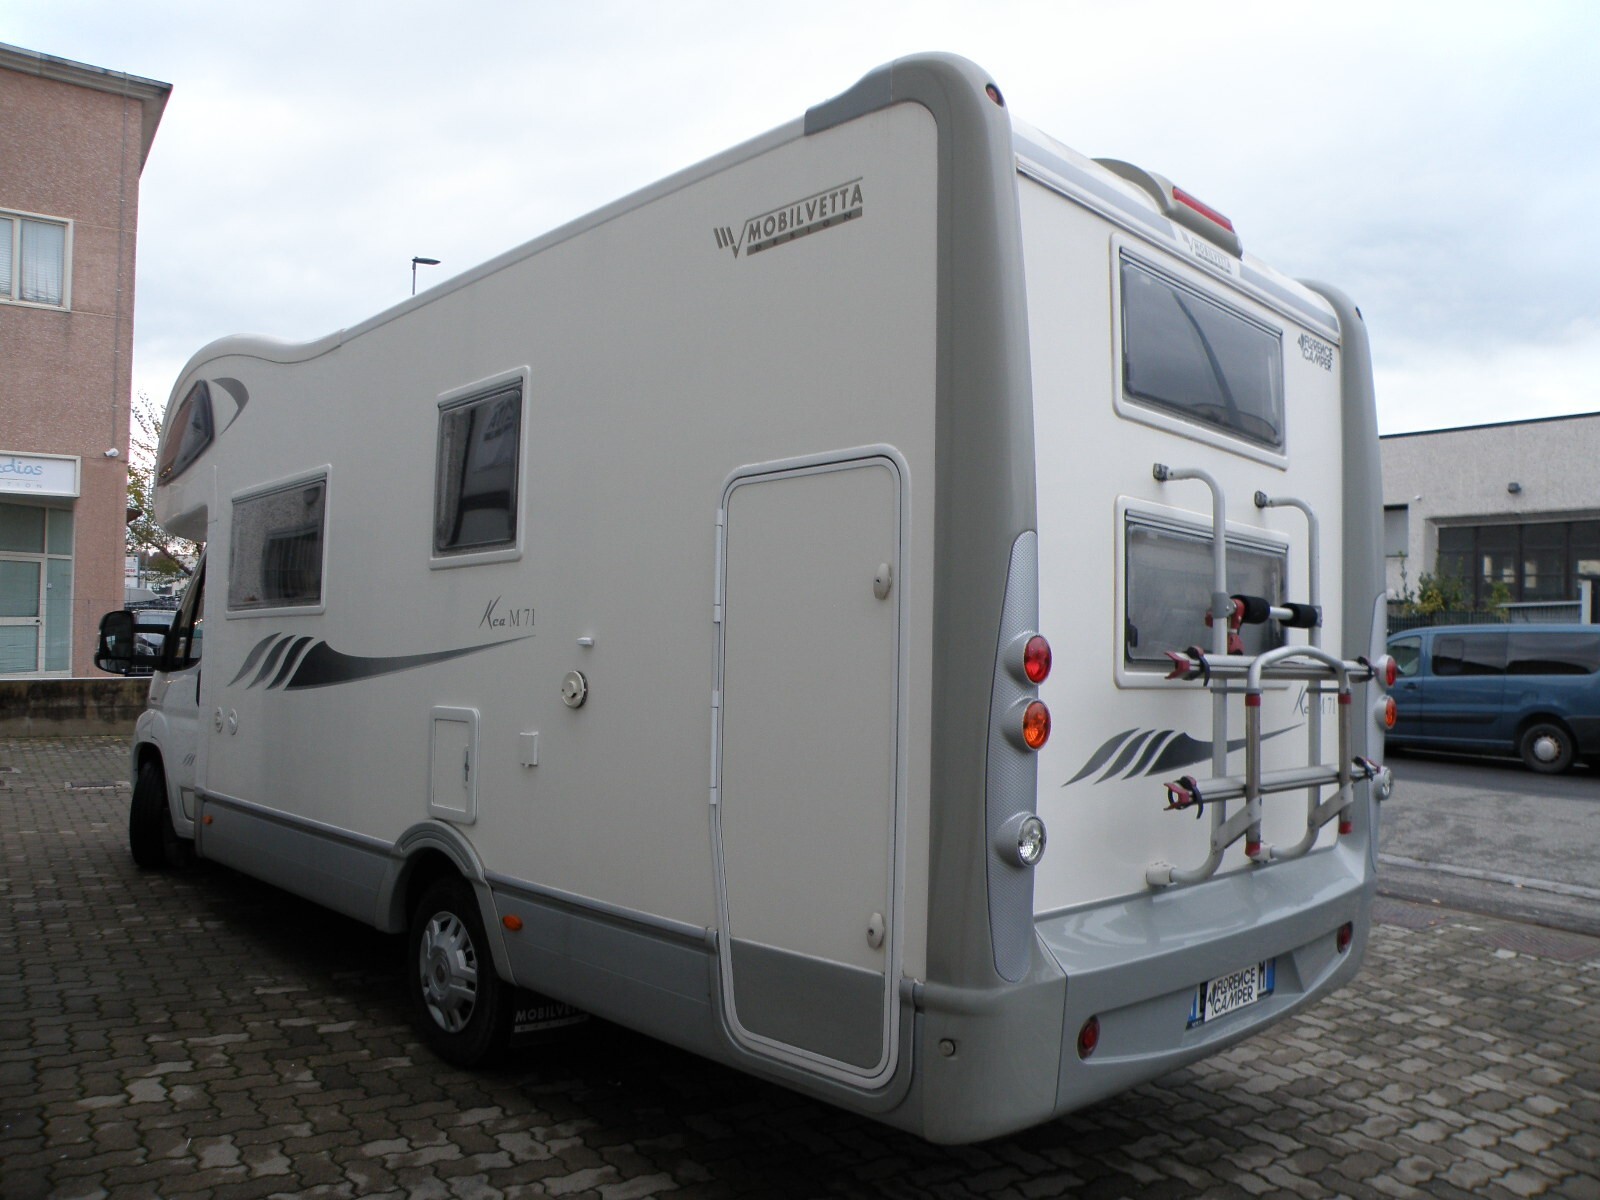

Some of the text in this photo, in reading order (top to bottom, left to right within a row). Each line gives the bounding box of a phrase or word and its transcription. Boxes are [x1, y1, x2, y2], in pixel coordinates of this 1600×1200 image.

[748, 183, 863, 244] MOBILVETTA
[509, 608, 520, 628] M
[523, 608, 535, 627] 71
[1216, 967, 1256, 995] FLORENCE
[1213, 985, 1254, 1014] CAMPER
